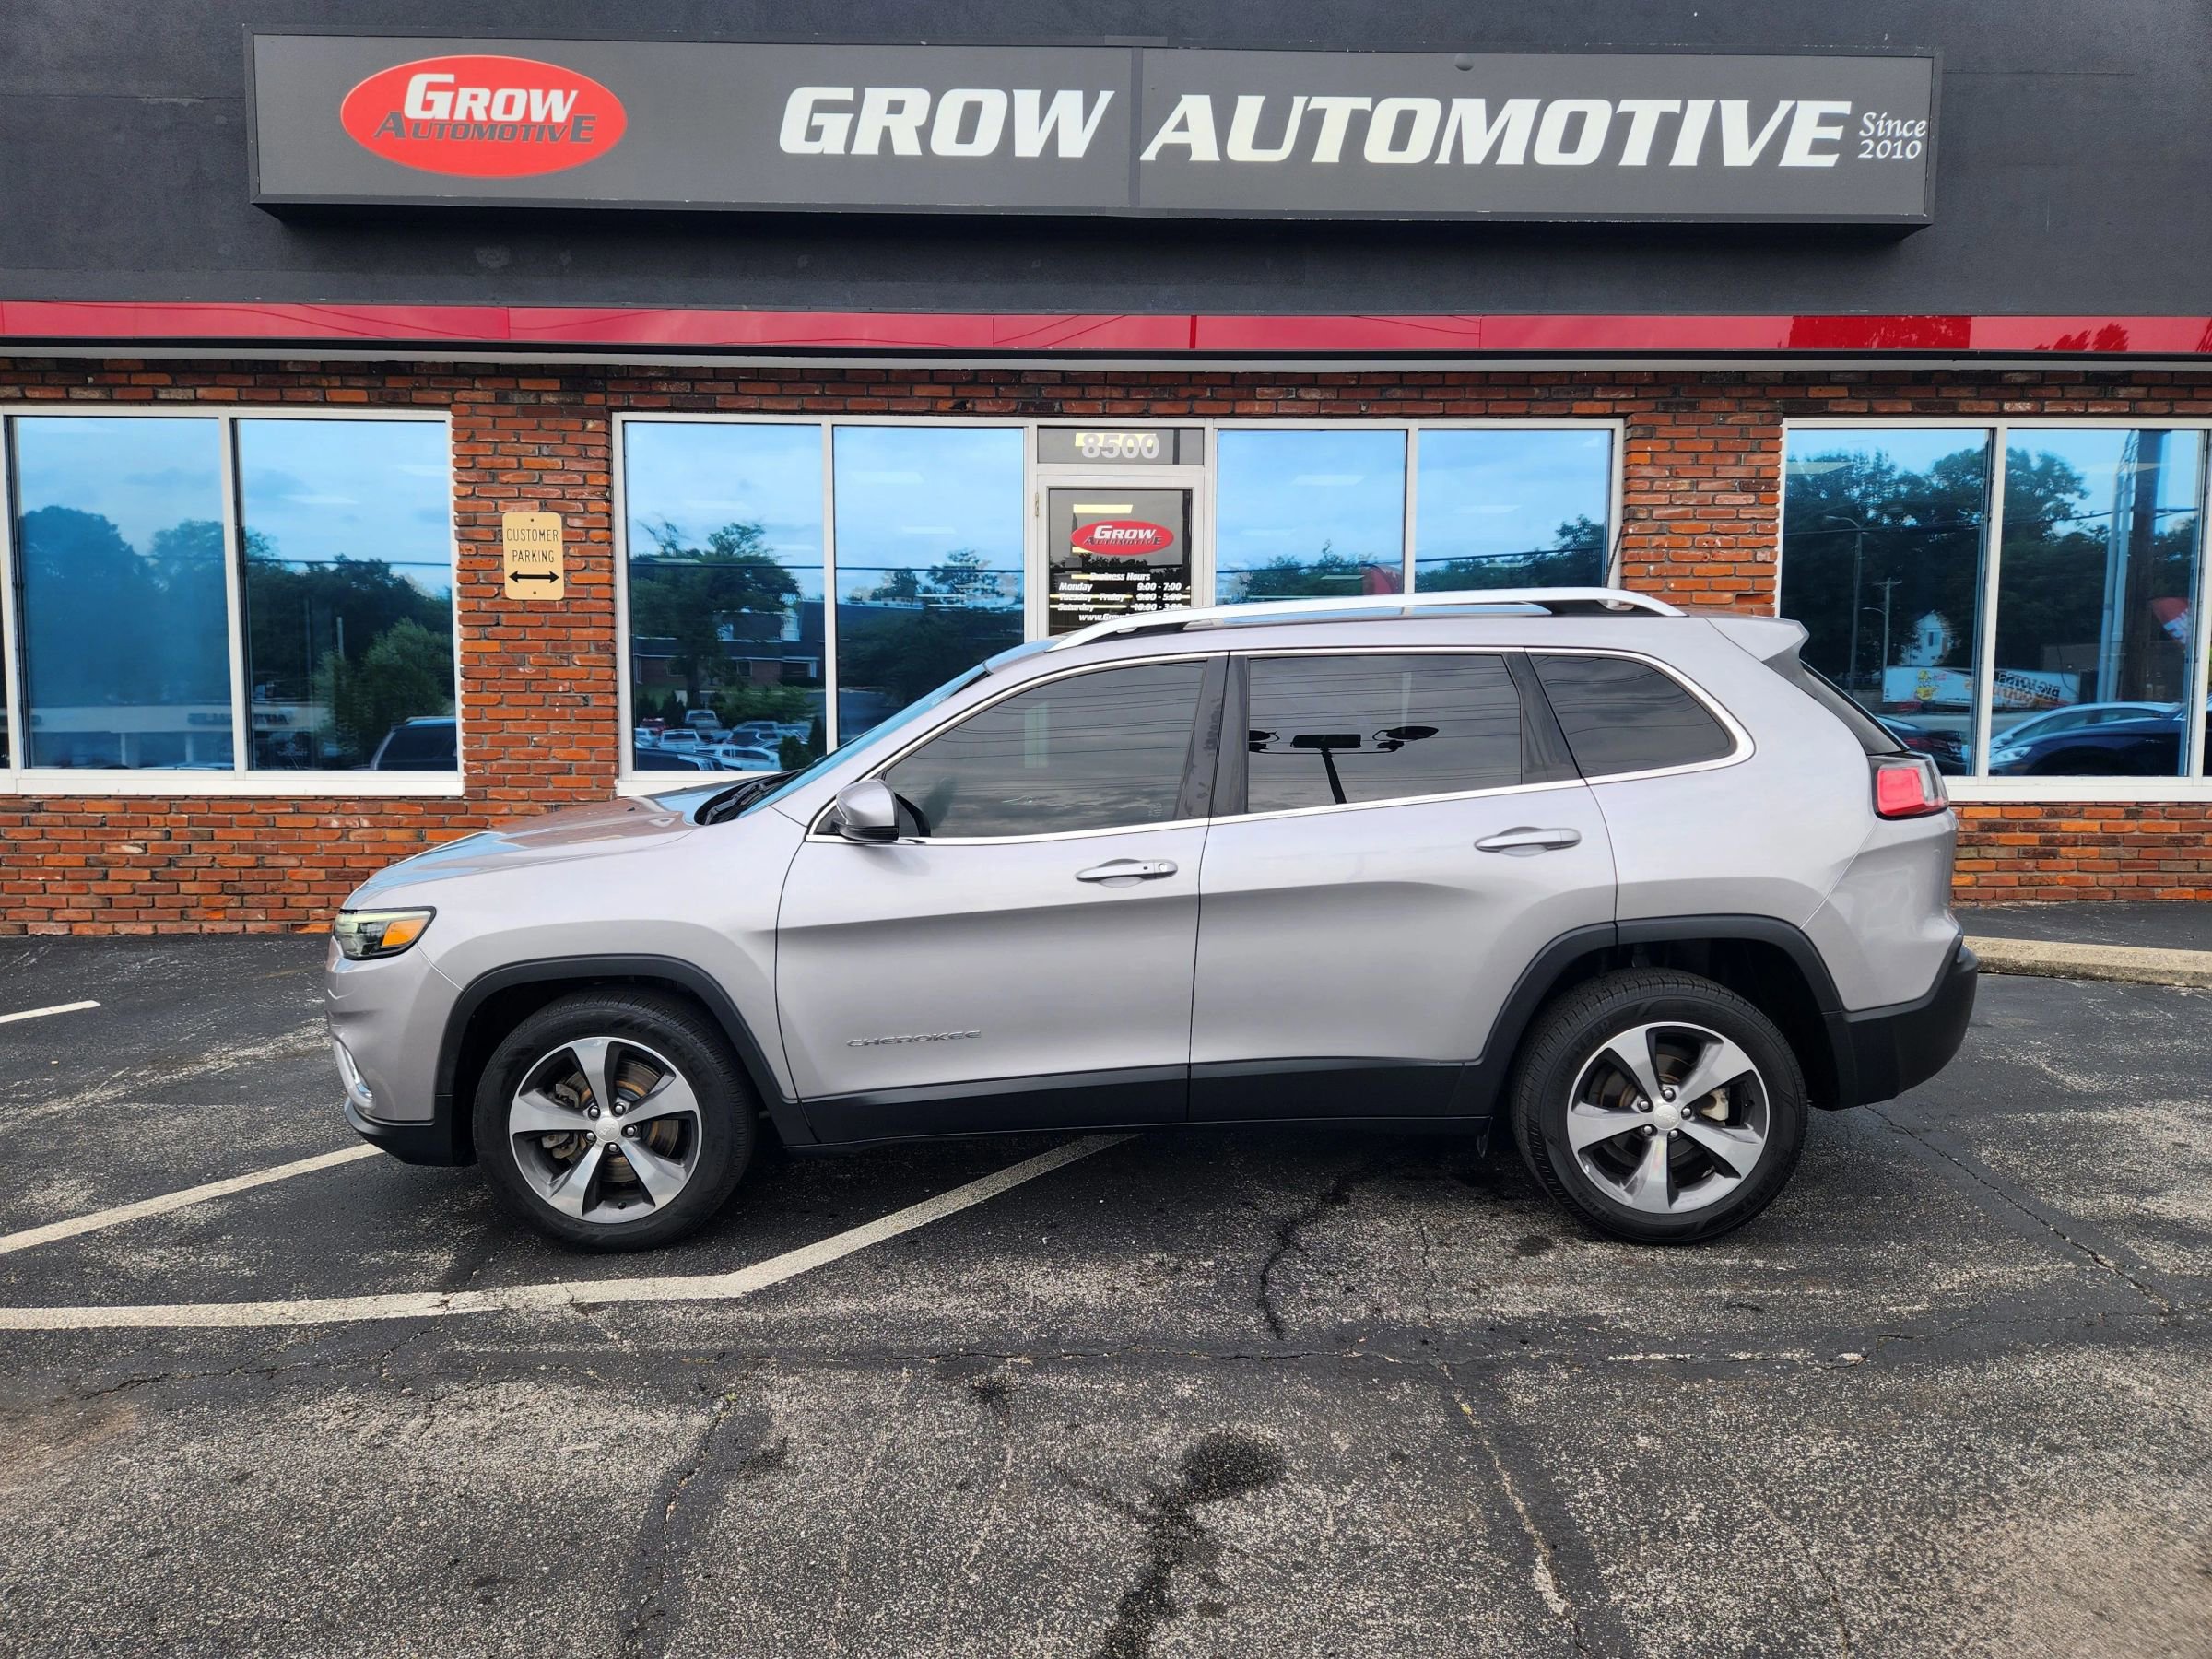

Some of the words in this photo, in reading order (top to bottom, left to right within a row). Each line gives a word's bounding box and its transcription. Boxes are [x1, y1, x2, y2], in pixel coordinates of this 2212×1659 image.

[403, 73, 578, 122] GROW
[373, 112, 596, 143] AUTOMOTIVE
[780, 87, 1115, 158] GROW
[1139, 94, 1852, 167] AUTOMOTIVE
[1859, 112, 1927, 137] Since
[1857, 139, 1922, 159] 2010
[1081, 433, 1159, 459] 8500
[506, 528, 559, 542] CUSTOMER
[1094, 525, 1157, 539] GROW
[512, 550, 554, 562] PARKING
[1126, 572, 1150, 581] Hours
[1059, 582, 1093, 592] Monday
[1136, 582, 1157, 591] 9:00
[1163, 582, 1182, 591] 7:00
[846, 1030, 982, 1047] CHEROKEE
